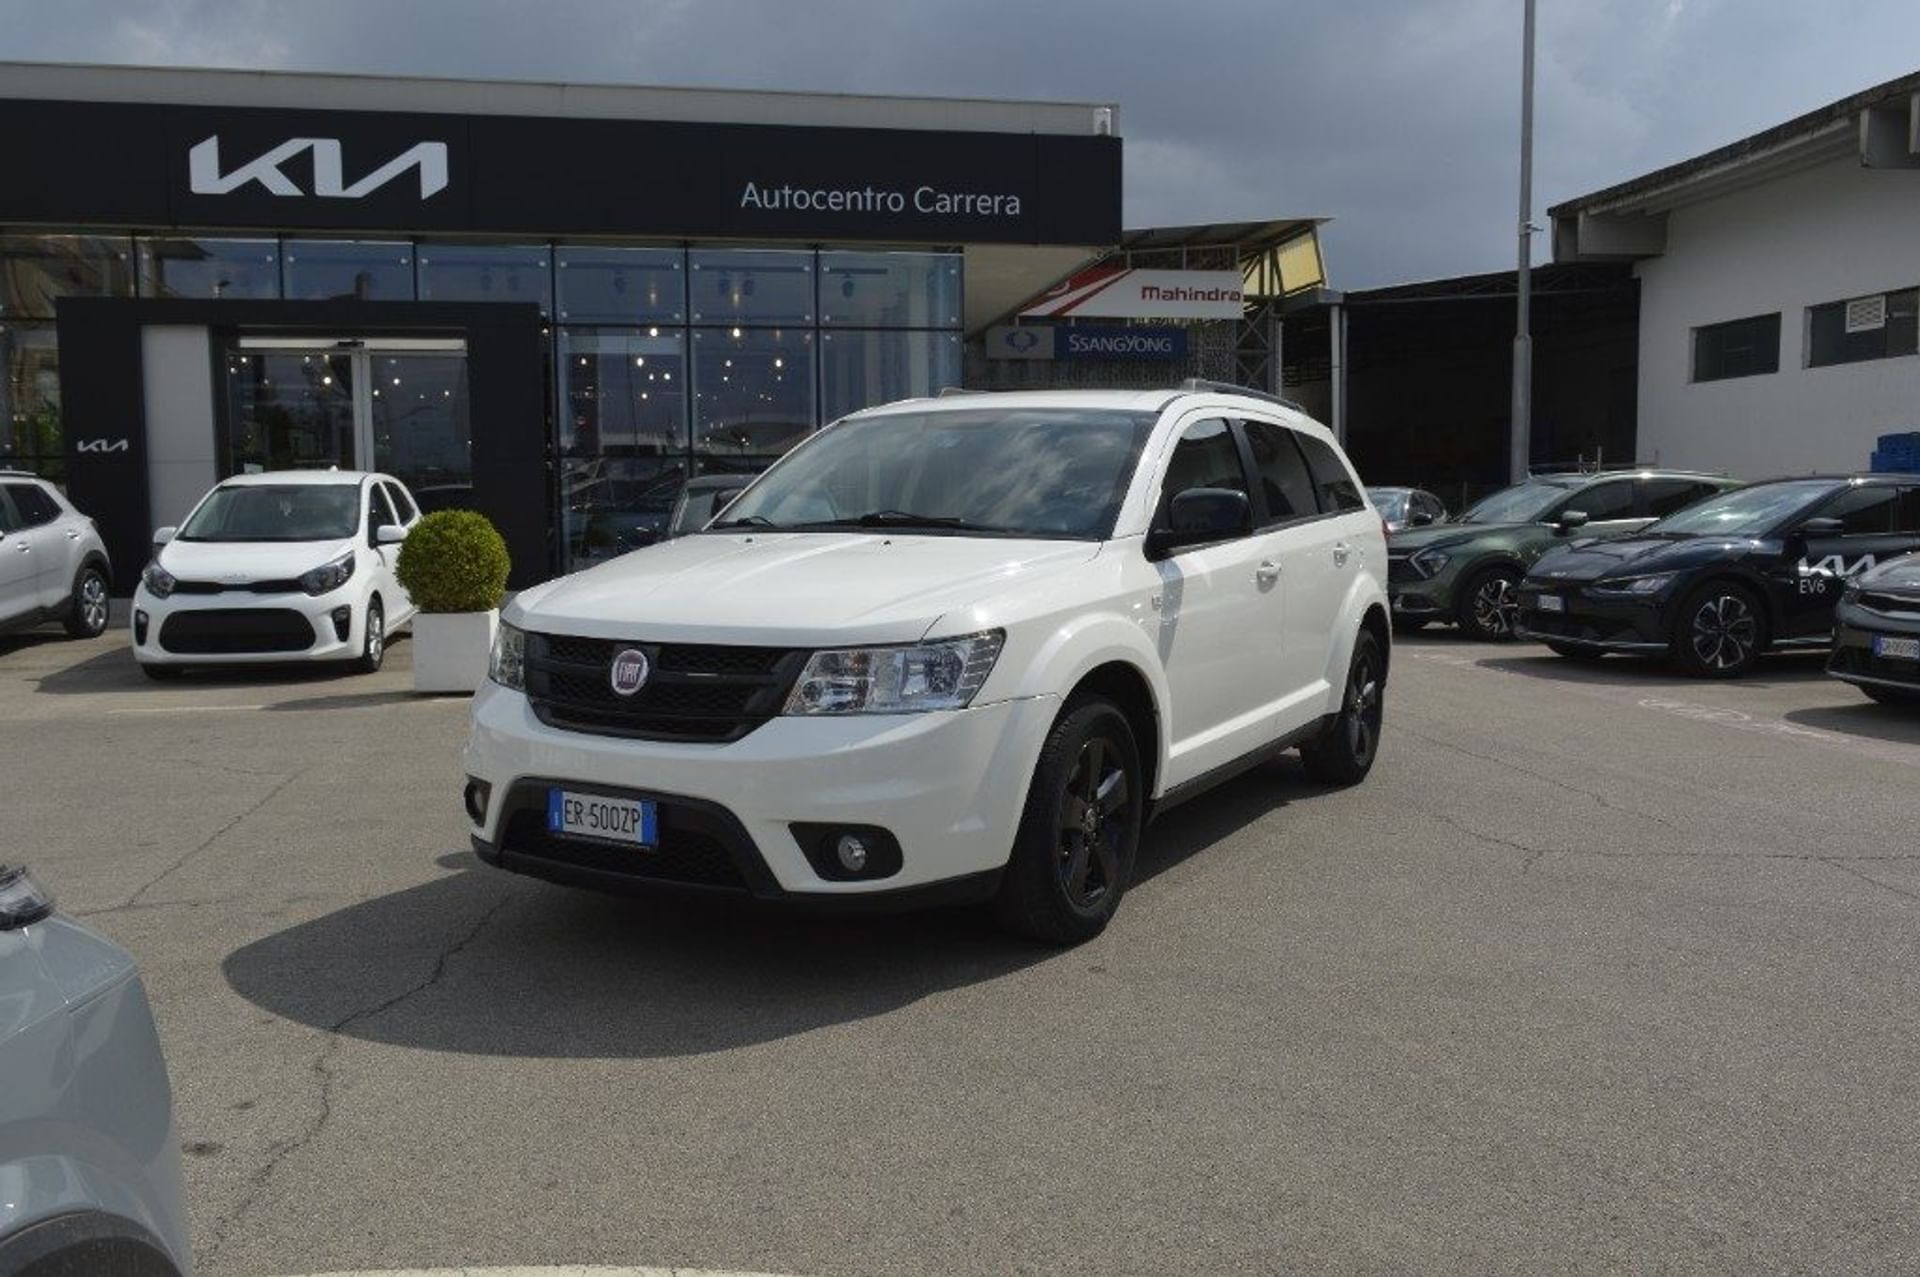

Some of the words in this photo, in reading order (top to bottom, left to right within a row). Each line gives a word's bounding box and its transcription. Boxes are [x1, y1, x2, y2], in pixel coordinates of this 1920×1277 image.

[189, 135, 448, 199] KIA
[740, 182, 905, 212] Autocentro
[913, 186, 1021, 215] Carrera
[1141, 285, 1242, 303] Mahindra
[1800, 579, 1826, 594] EV6
[618, 662, 640, 683] FIAT
[564, 799, 584, 826] ER
[588, 803, 641, 834] 500ZP
